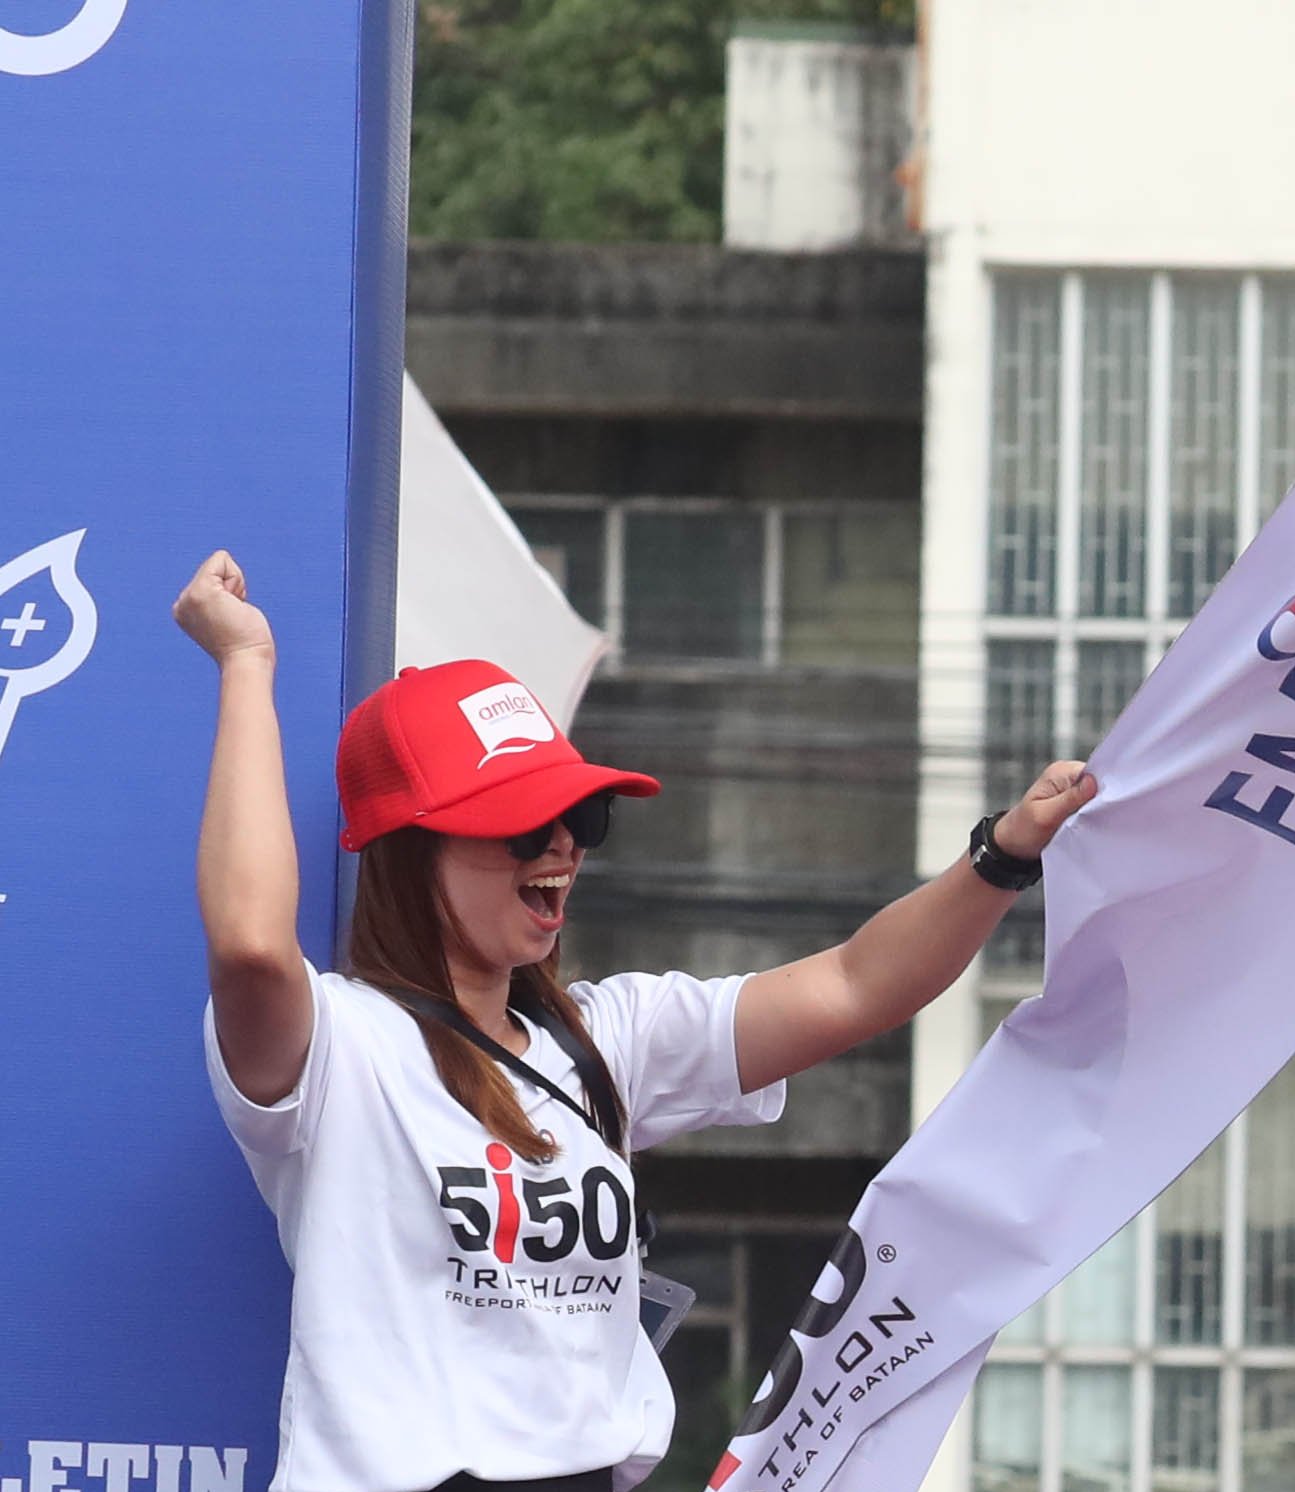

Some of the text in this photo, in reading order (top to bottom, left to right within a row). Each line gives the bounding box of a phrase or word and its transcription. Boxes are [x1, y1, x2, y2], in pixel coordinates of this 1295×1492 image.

[445, 1291, 531, 1310] FREEPOR
[820, 1405, 845, 1441] OF
[849, 1331, 936, 1403] BATAAN
